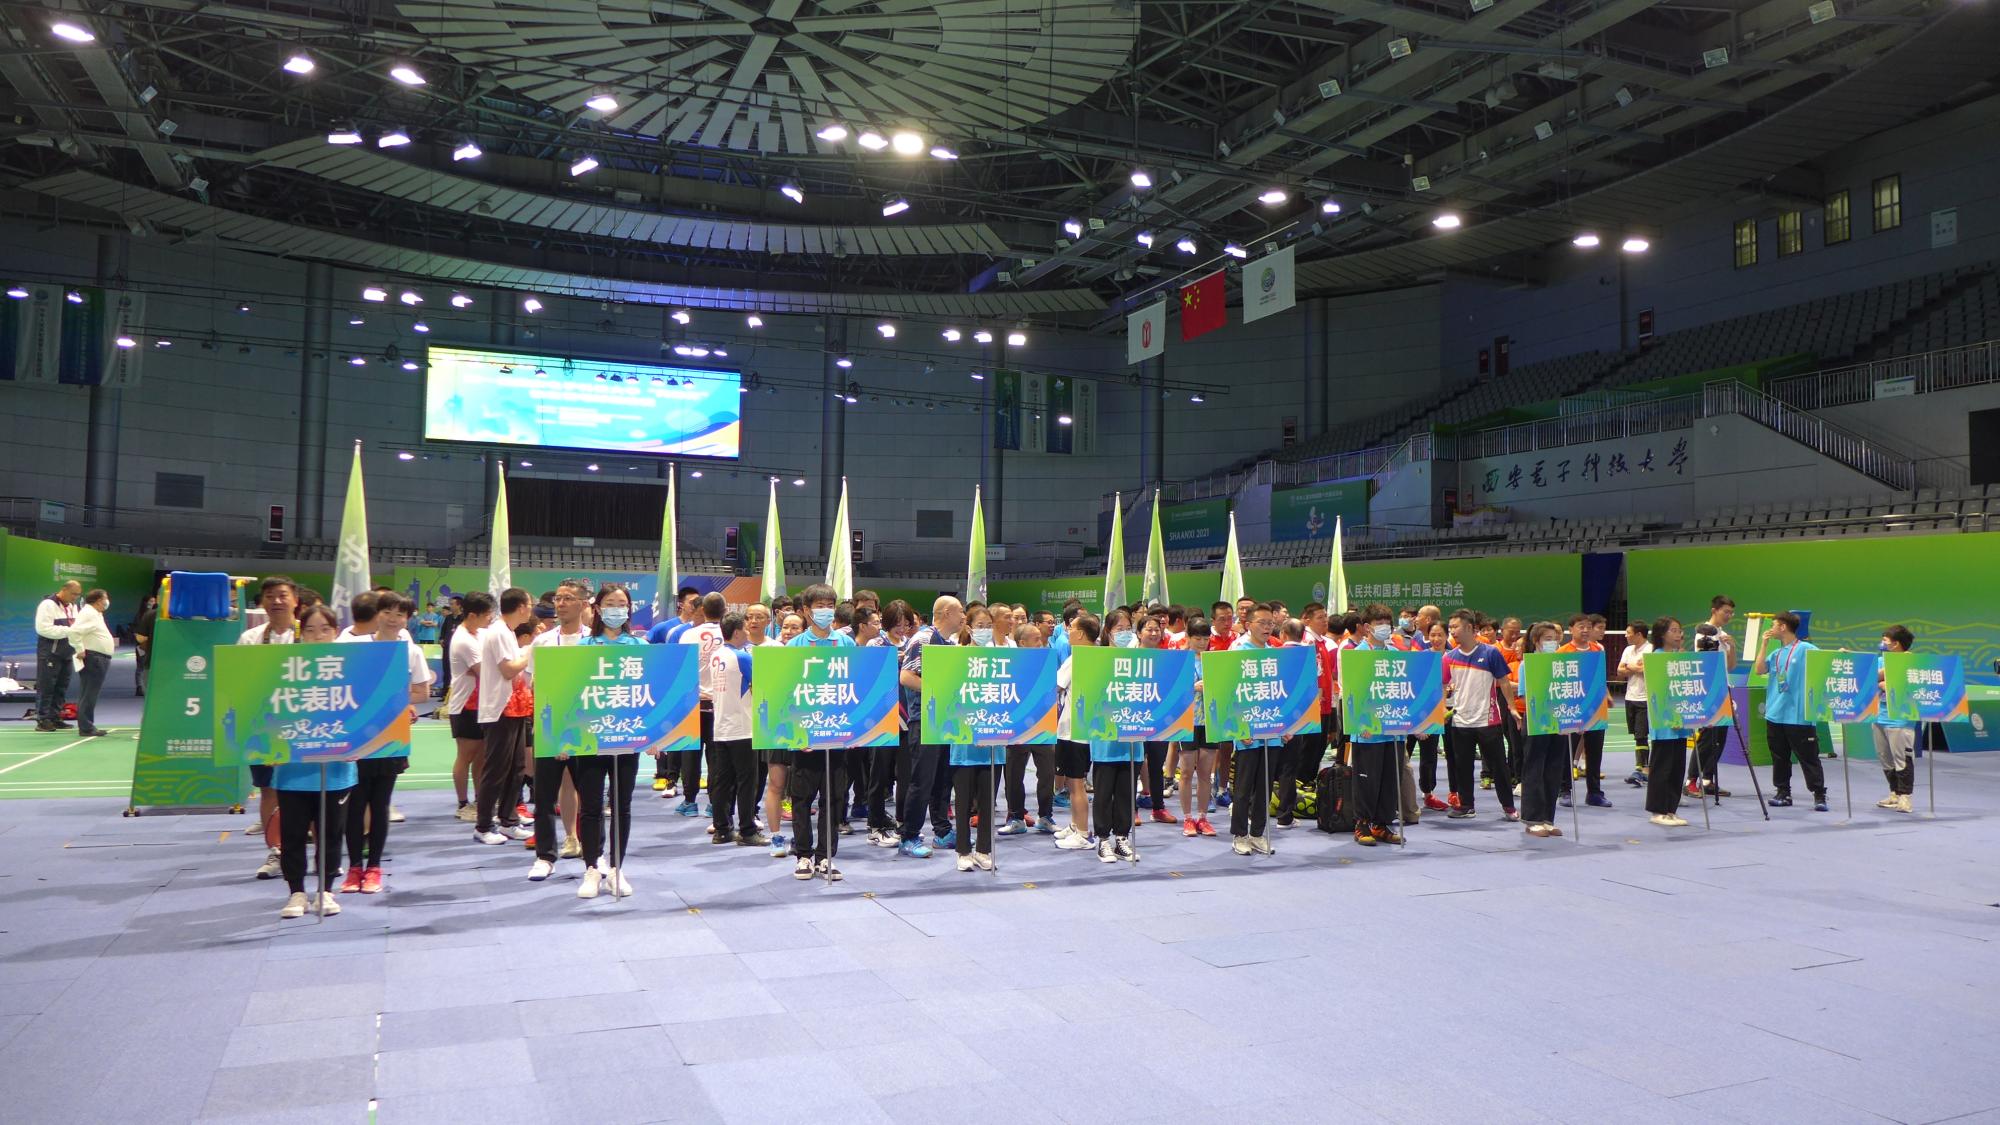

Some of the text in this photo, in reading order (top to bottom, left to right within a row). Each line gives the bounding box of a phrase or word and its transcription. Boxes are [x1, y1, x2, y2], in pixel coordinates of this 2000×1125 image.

[1169, 528, 1209, 541] SHAANXI 2021
[1445, 598, 1464, 606] CHINA
[282, 656, 344, 682] 北京
[590, 656, 644, 680] 上海
[802, 656, 848, 679] 广州
[968, 656, 1012, 679] 浙江
[1114, 658, 1153, 678] 四川
[1241, 658, 1278, 678] 海南
[1374, 659, 1407, 678] 武汉
[1552, 660, 1579, 678] 陕西
[1666, 660, 1704, 677] 教职工
[1831, 659, 1854, 674] 学生
[1906, 668, 1944, 685] 裁判组
[794, 683, 860, 706] 代表队
[960, 682, 1020, 704] 代表队
[1106, 682, 1162, 703] 代表队
[1236, 680, 1288, 702] 代表队
[1370, 682, 1416, 700] 代表队
[1548, 680, 1586, 700] 代表队
[1668, 678, 1707, 697] 代表队
[1825, 678, 1858, 693] 代表队
[184, 698, 200, 716] 5
[270, 685, 358, 714] 代表队
[580, 684, 656, 710] 代表队
